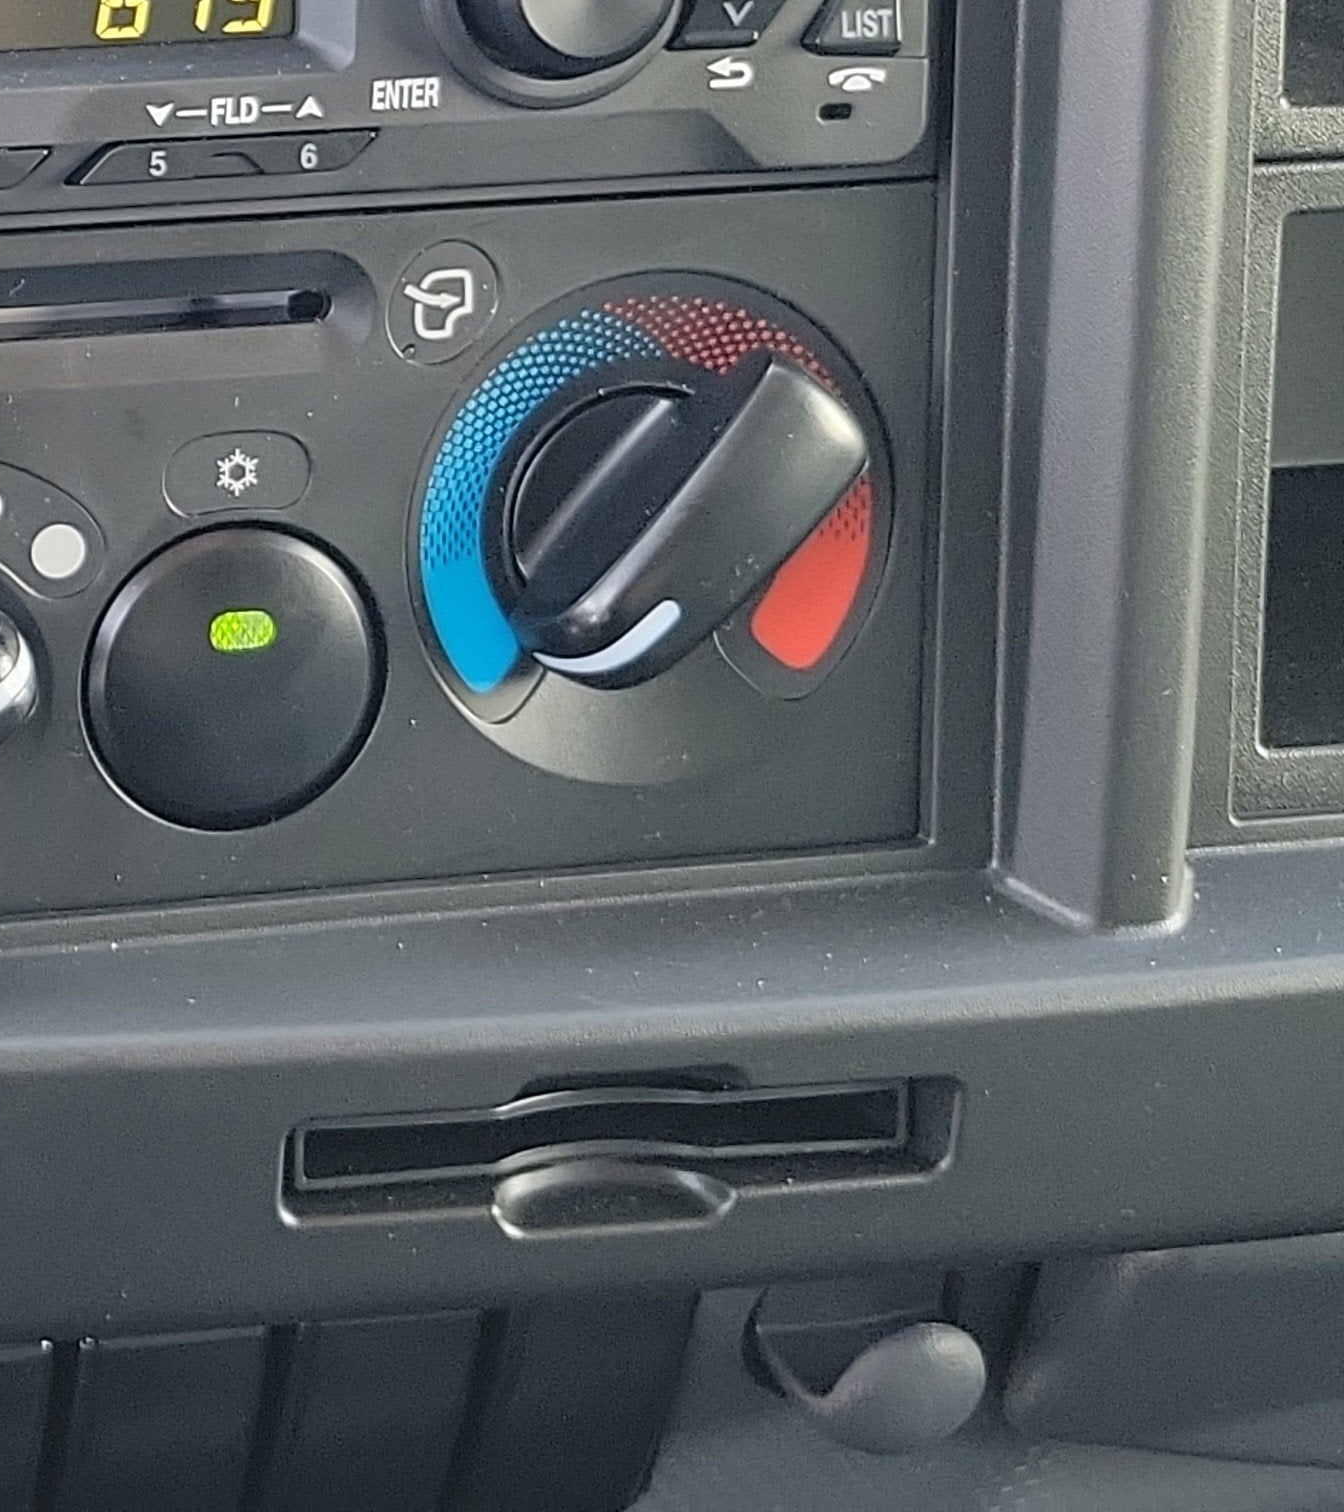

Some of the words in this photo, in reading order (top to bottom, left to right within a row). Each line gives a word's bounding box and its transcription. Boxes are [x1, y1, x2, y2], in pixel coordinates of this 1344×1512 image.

[841, 9, 893, 39] LIST
[371, 79, 440, 111] ENTER
[210, 96, 259, 125] FLD
[149, 151, 167, 176] 5
[300, 144, 318, 169] 6
